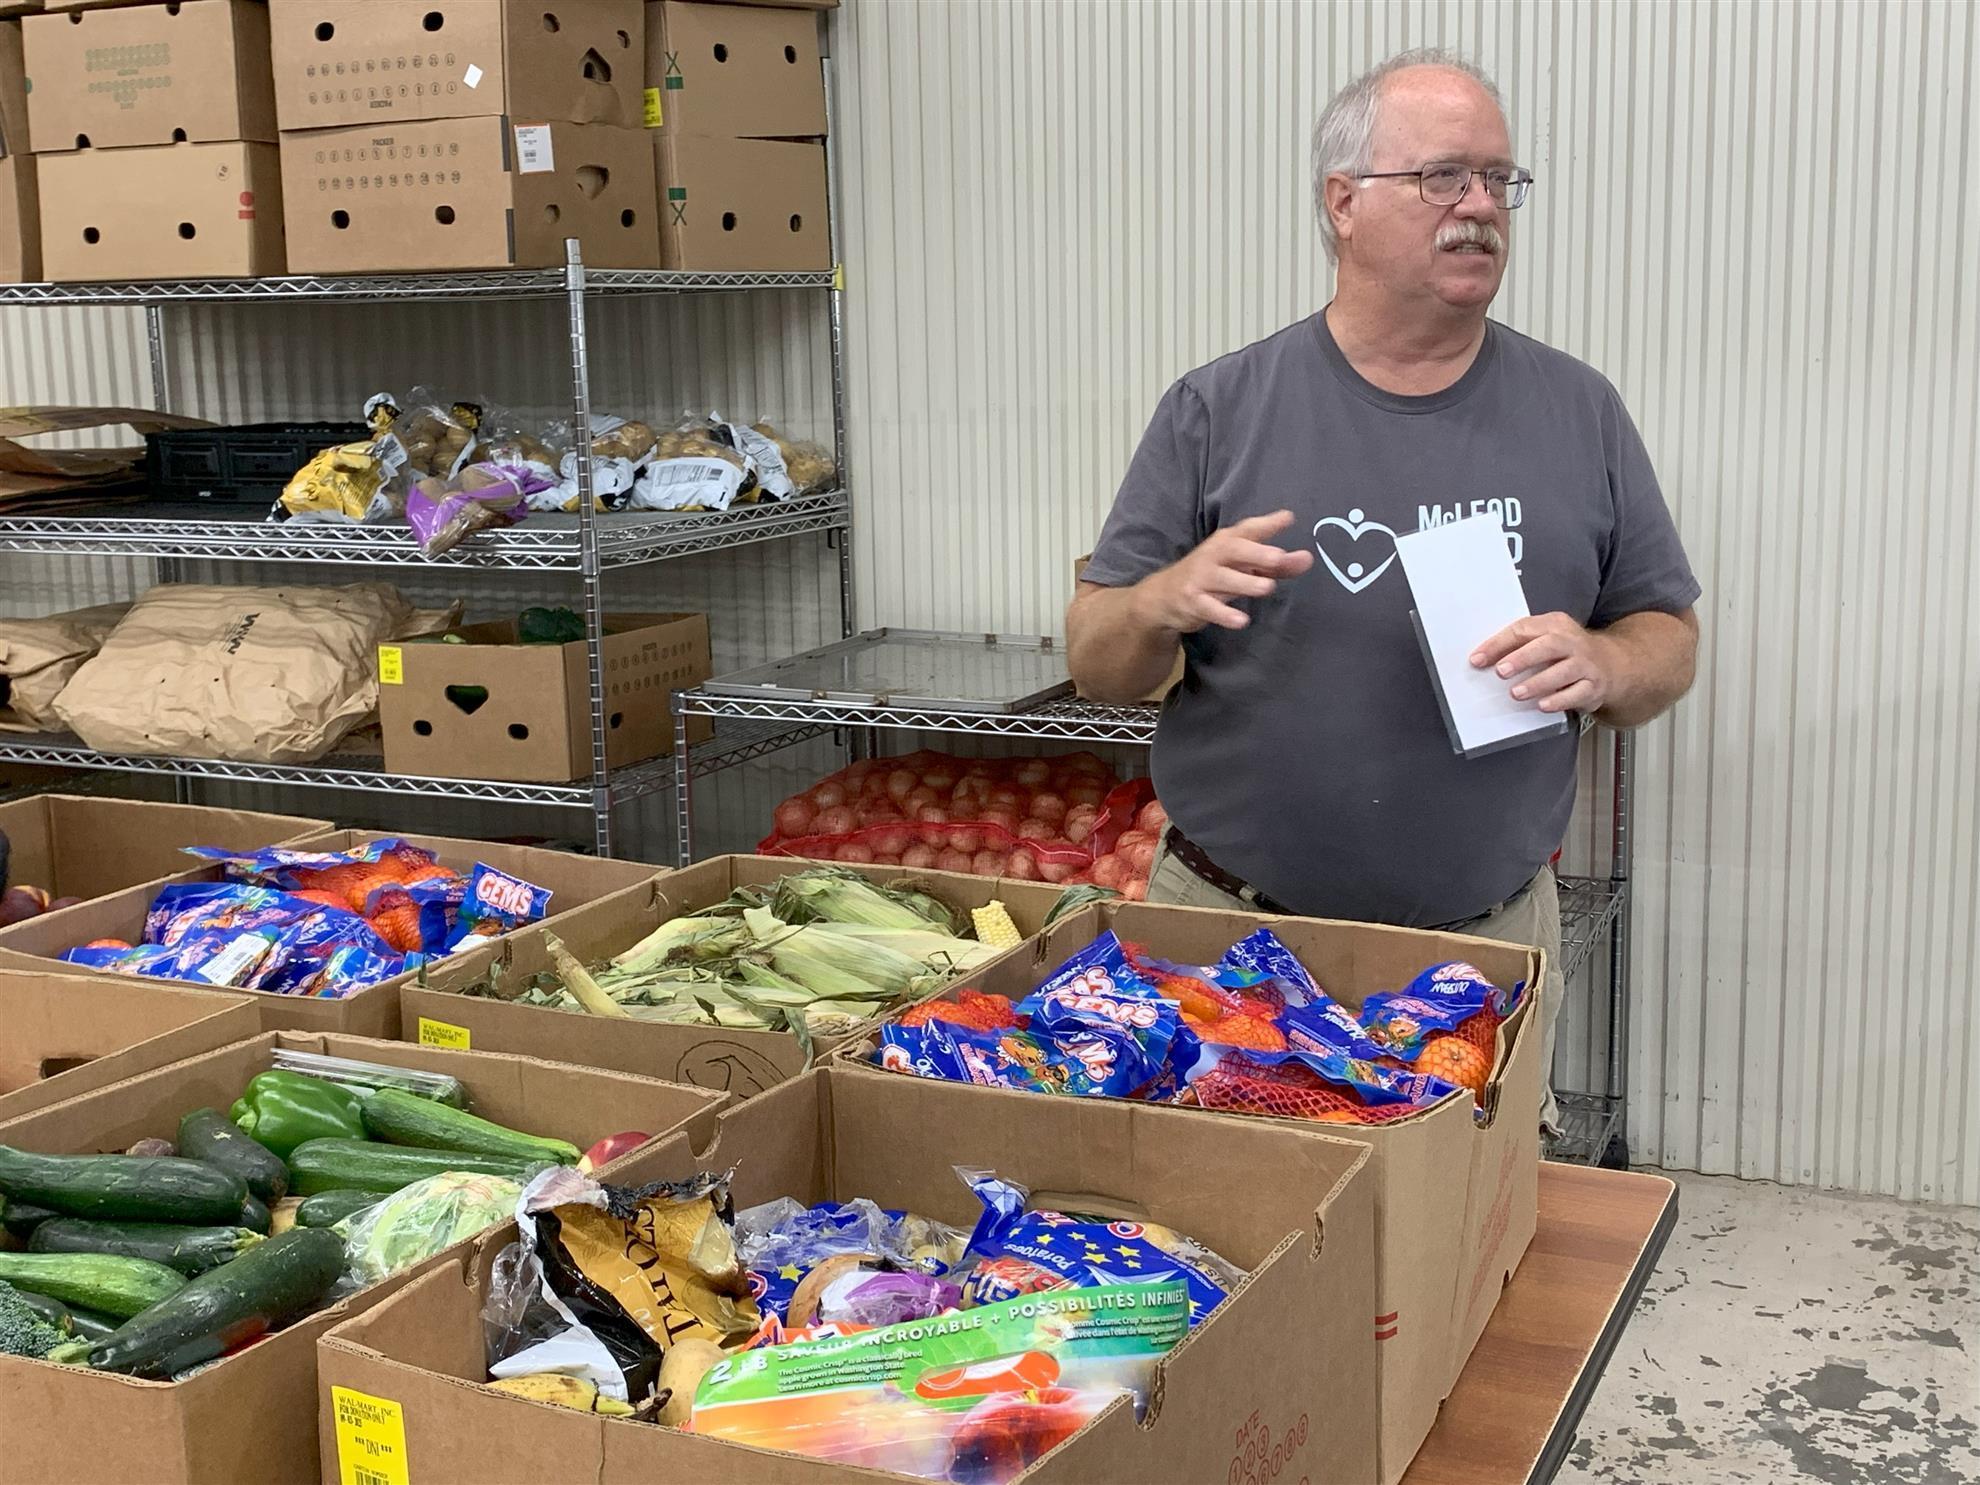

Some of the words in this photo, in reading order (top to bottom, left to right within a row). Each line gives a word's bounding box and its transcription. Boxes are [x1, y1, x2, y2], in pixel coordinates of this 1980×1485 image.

[1004, 1244, 1077, 1271] Potatoes
[861, 1315, 983, 1348] INCROYABLE
[1008, 1290, 1137, 1321] POSSIBILITÉS
[708, 1360, 733, 1386] 2
[1236, 1409, 1259, 1449] DATE
